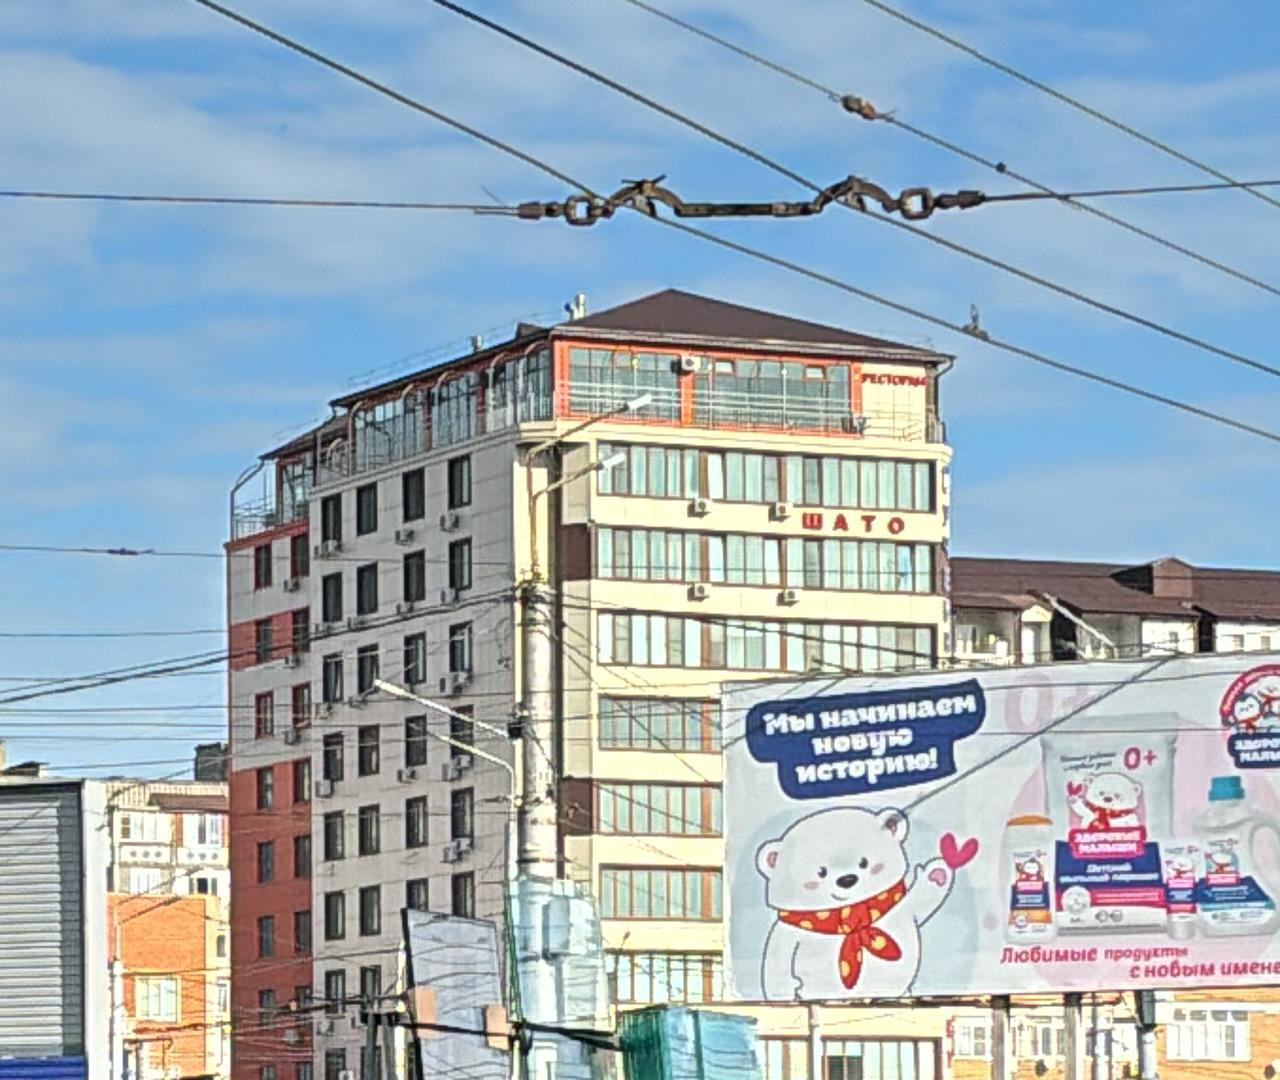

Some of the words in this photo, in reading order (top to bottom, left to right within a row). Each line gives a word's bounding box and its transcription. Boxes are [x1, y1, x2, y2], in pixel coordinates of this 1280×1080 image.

[801, 511, 905, 535] ШАТО
[763, 712, 815, 736] Мы
[819, 694, 978, 730] начинаем
[811, 727, 914, 757] новую
[794, 746, 938, 785] историю!
[1123, 746, 1158, 770] 0+
[1000, 946, 1098, 964] Любимые
[1144, 961, 1216, 979] новым
